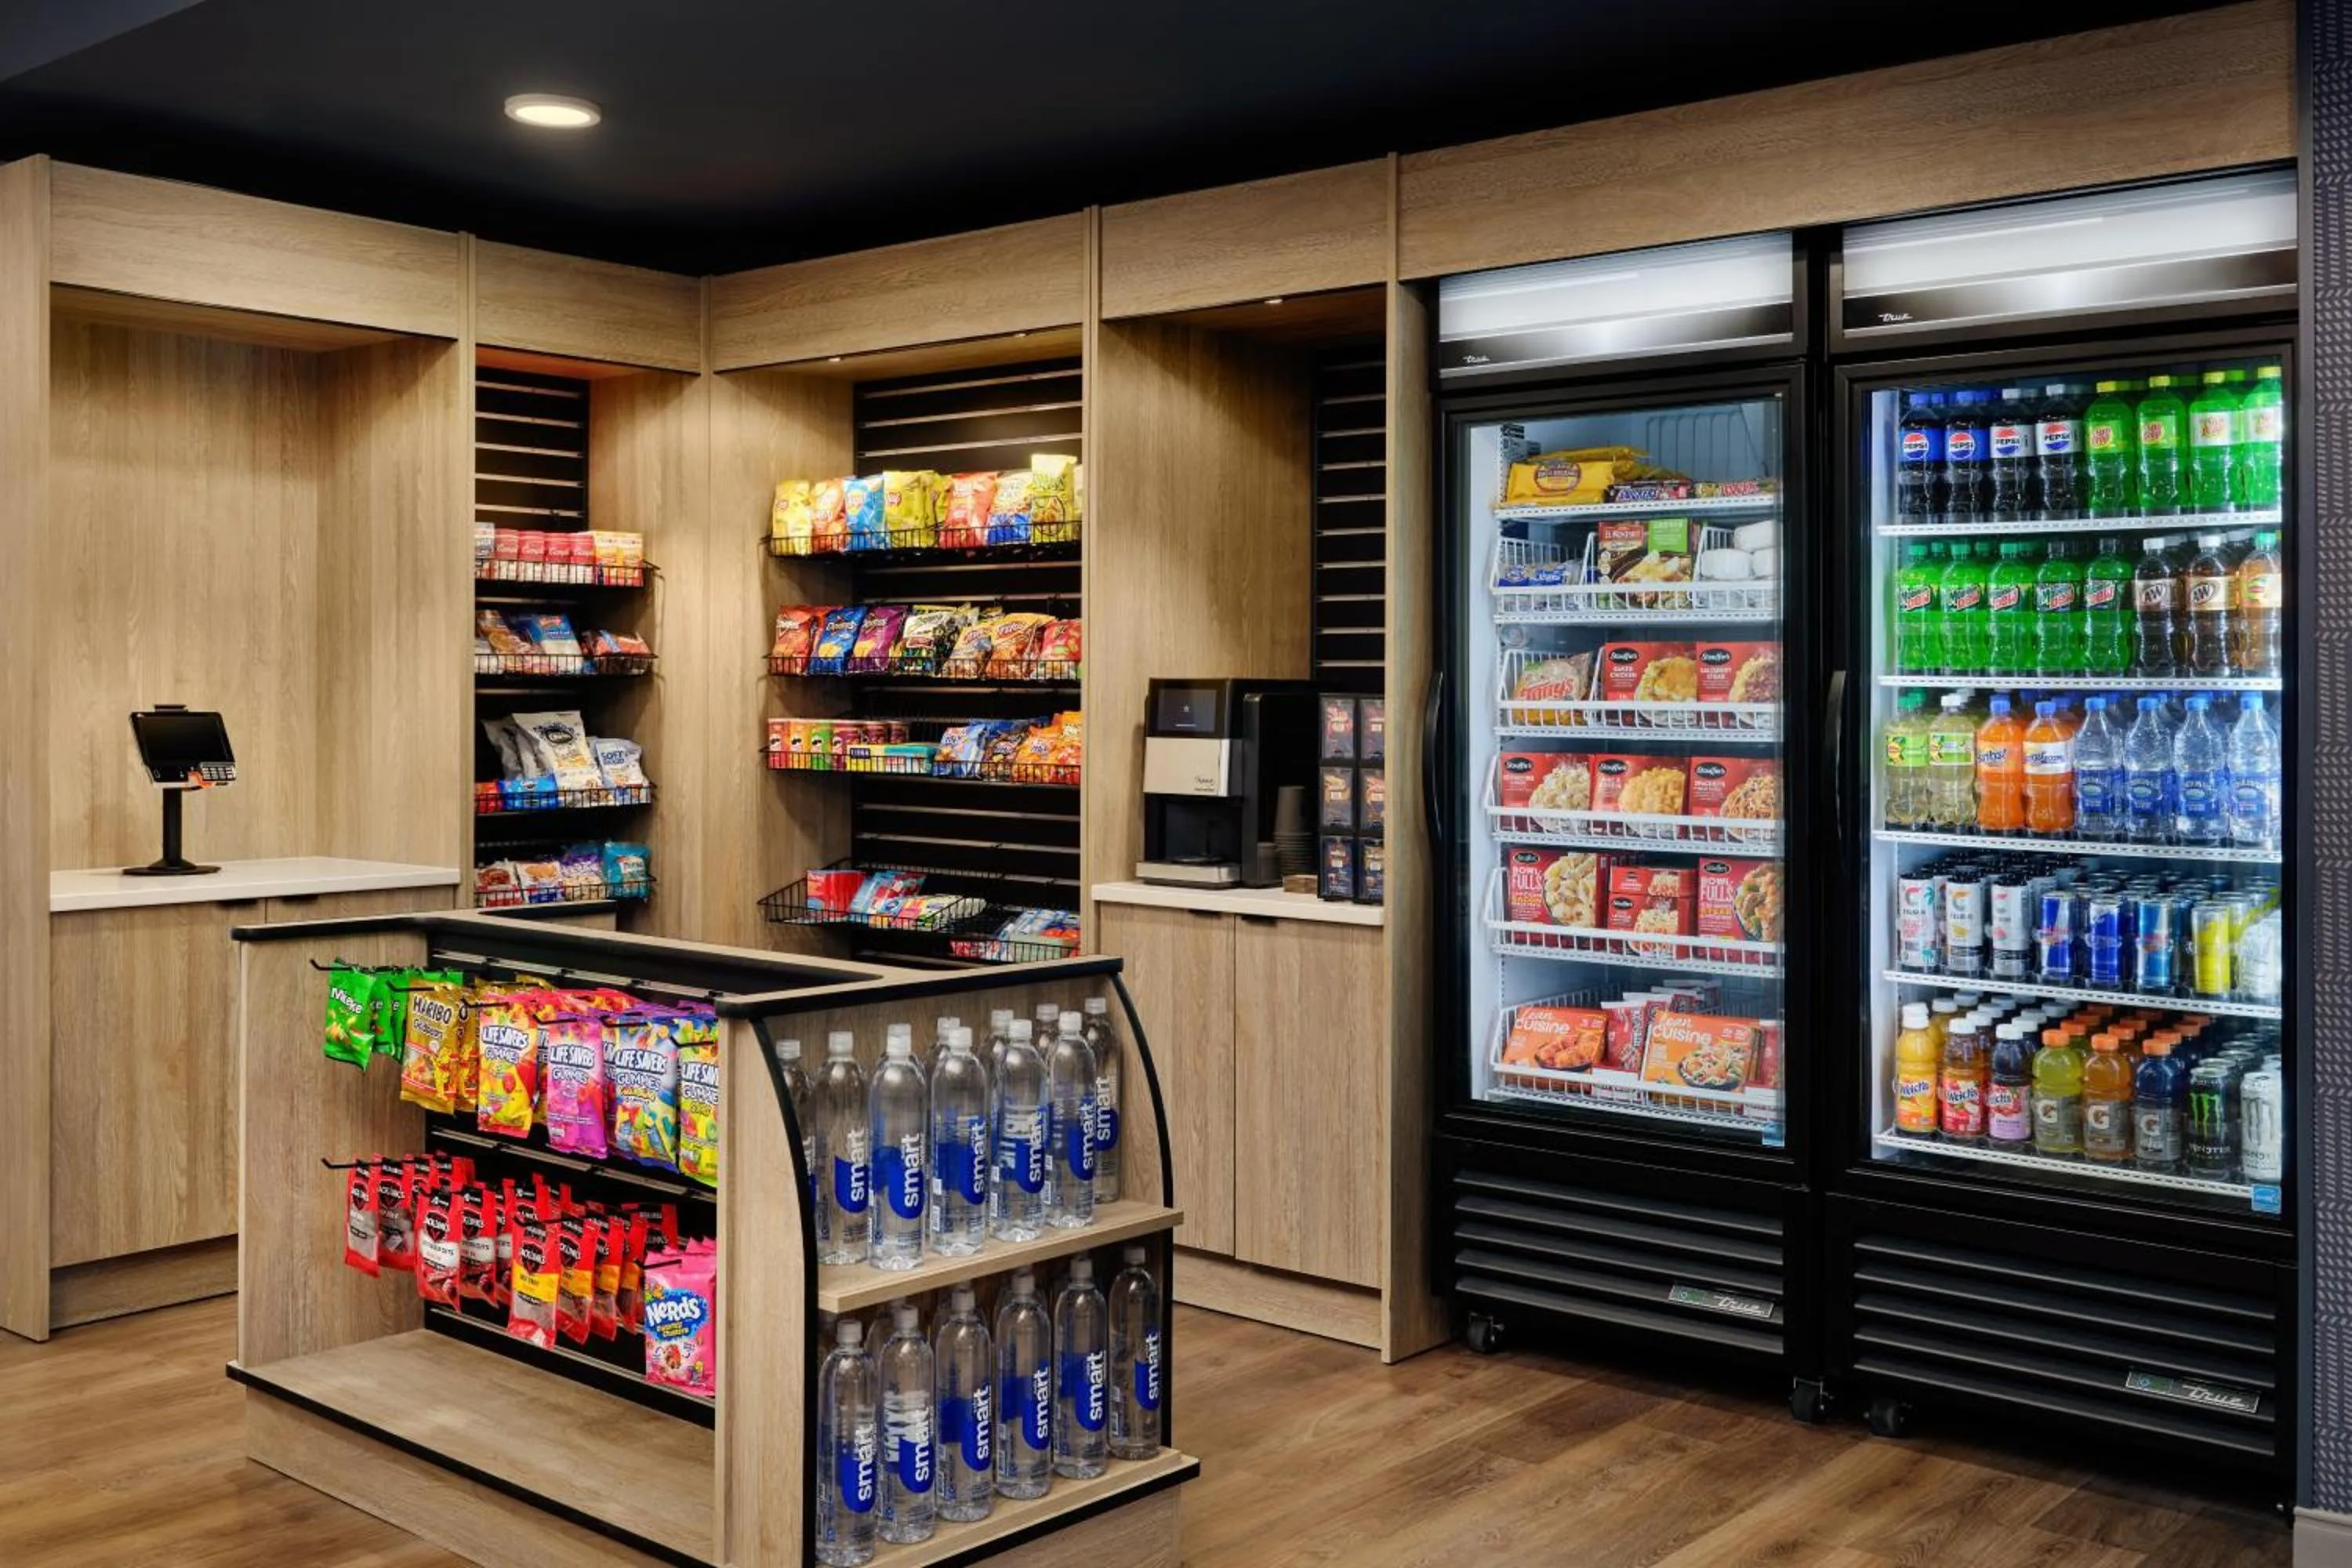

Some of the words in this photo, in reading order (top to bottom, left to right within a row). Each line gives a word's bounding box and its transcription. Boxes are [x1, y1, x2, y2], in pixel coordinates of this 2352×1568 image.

[1512, 874, 1543, 890] FULLS
[1700, 885, 1733, 902] FULLS
[412, 994, 453, 1025] HARIBO
[482, 1026, 498, 1044] LIFE
[499, 1027, 528, 1050] SAVERS
[550, 1045, 566, 1065] LIFE
[566, 1045, 595, 1069] SAVERS
[616, 1050, 635, 1069] LIFE
[635, 1051, 668, 1075] SAVERS
[681, 1062, 701, 1082] LIFE
[552, 1066, 590, 1085] GUMMIES
[616, 1071, 662, 1091] GUMMIES
[682, 1084, 719, 1105] GUMMIE
[1095, 1076, 1112, 1142] smart
[1079, 1102, 1094, 1171] smart
[847, 1127, 866, 1203] smart
[901, 1133, 920, 1208] smart
[970, 1120, 985, 1194] smart
[1146, 1333, 1160, 1400] smart
[1087, 1350, 1103, 1421] smart
[1034, 1367, 1049, 1439] smart
[974, 1385, 989, 1461] smart
